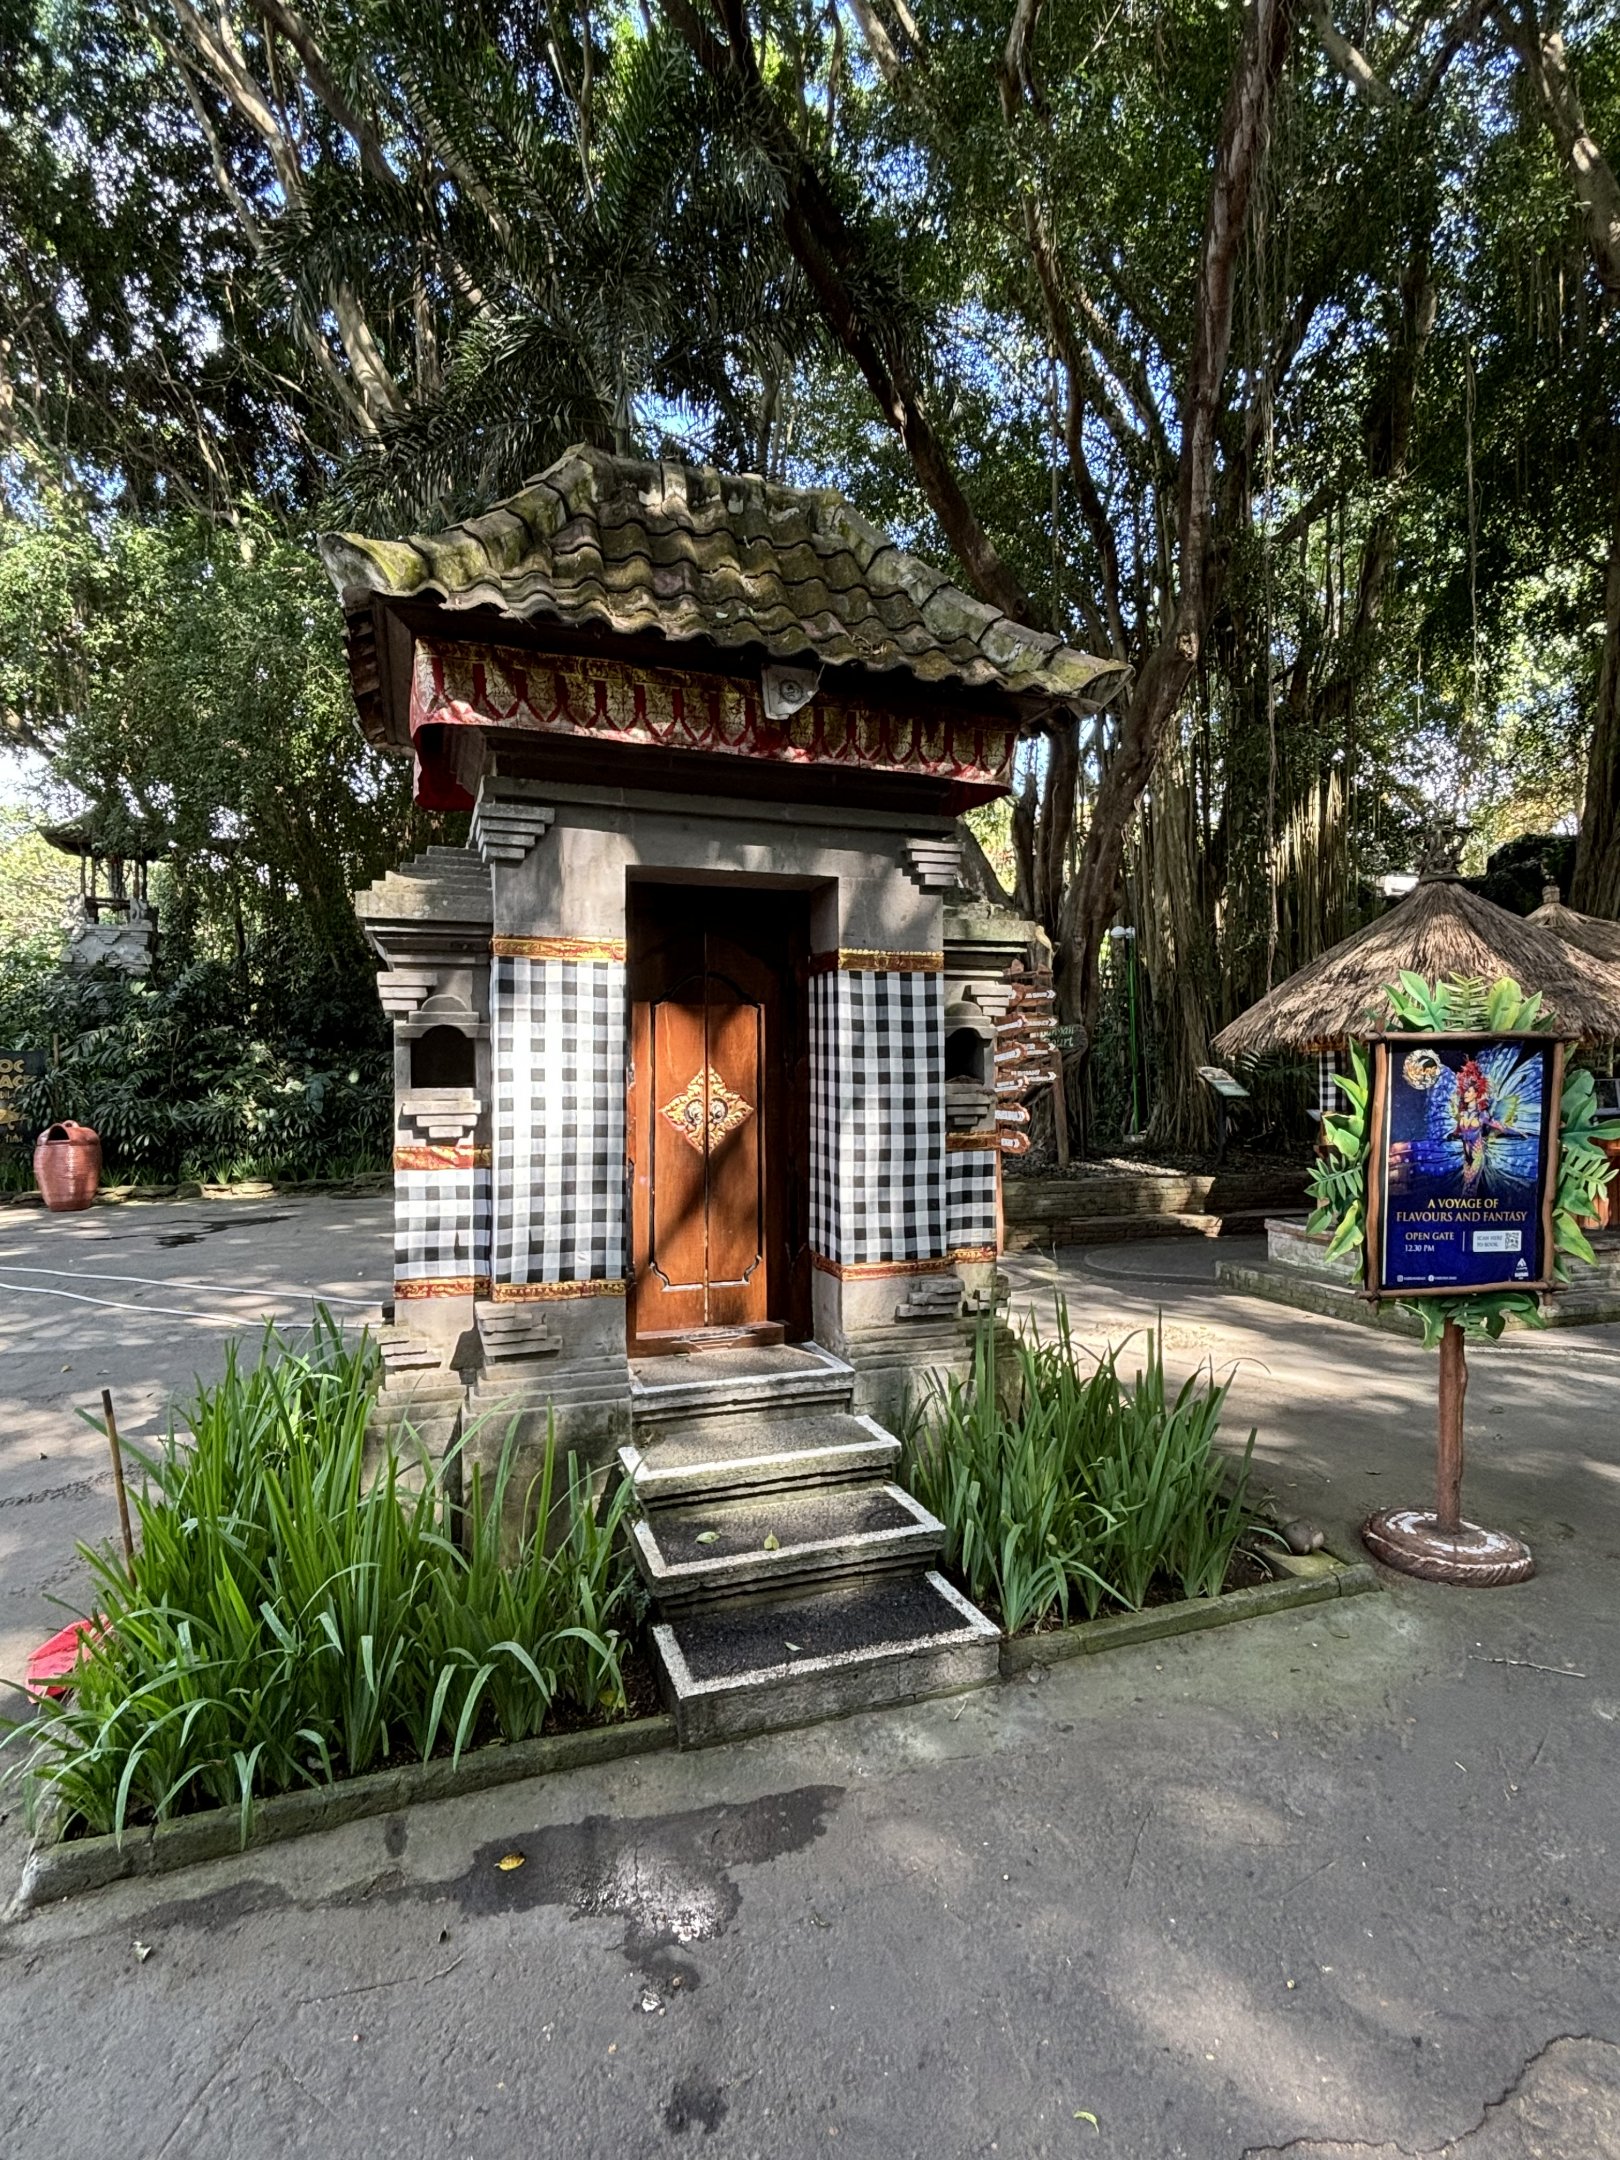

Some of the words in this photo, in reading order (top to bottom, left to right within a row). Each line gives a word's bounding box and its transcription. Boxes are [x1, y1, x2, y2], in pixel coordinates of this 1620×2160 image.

[1427, 1198, 1436, 1209] A
[1437, 1198, 1482, 1209] VOYAGE
[1483, 1198, 1499, 1209] OF
[1396, 1211, 1453, 1222] FLAVOURS
[1454, 1211, 1481, 1222] AND
[1482, 1210, 1528, 1222] FANTASY
[1405, 1231, 1430, 1241] OPEN
[1431, 1231, 1455, 1241] GATE
[1405, 1244, 1422, 1252] 12.30
[1423, 1244, 1435, 1252] PM
